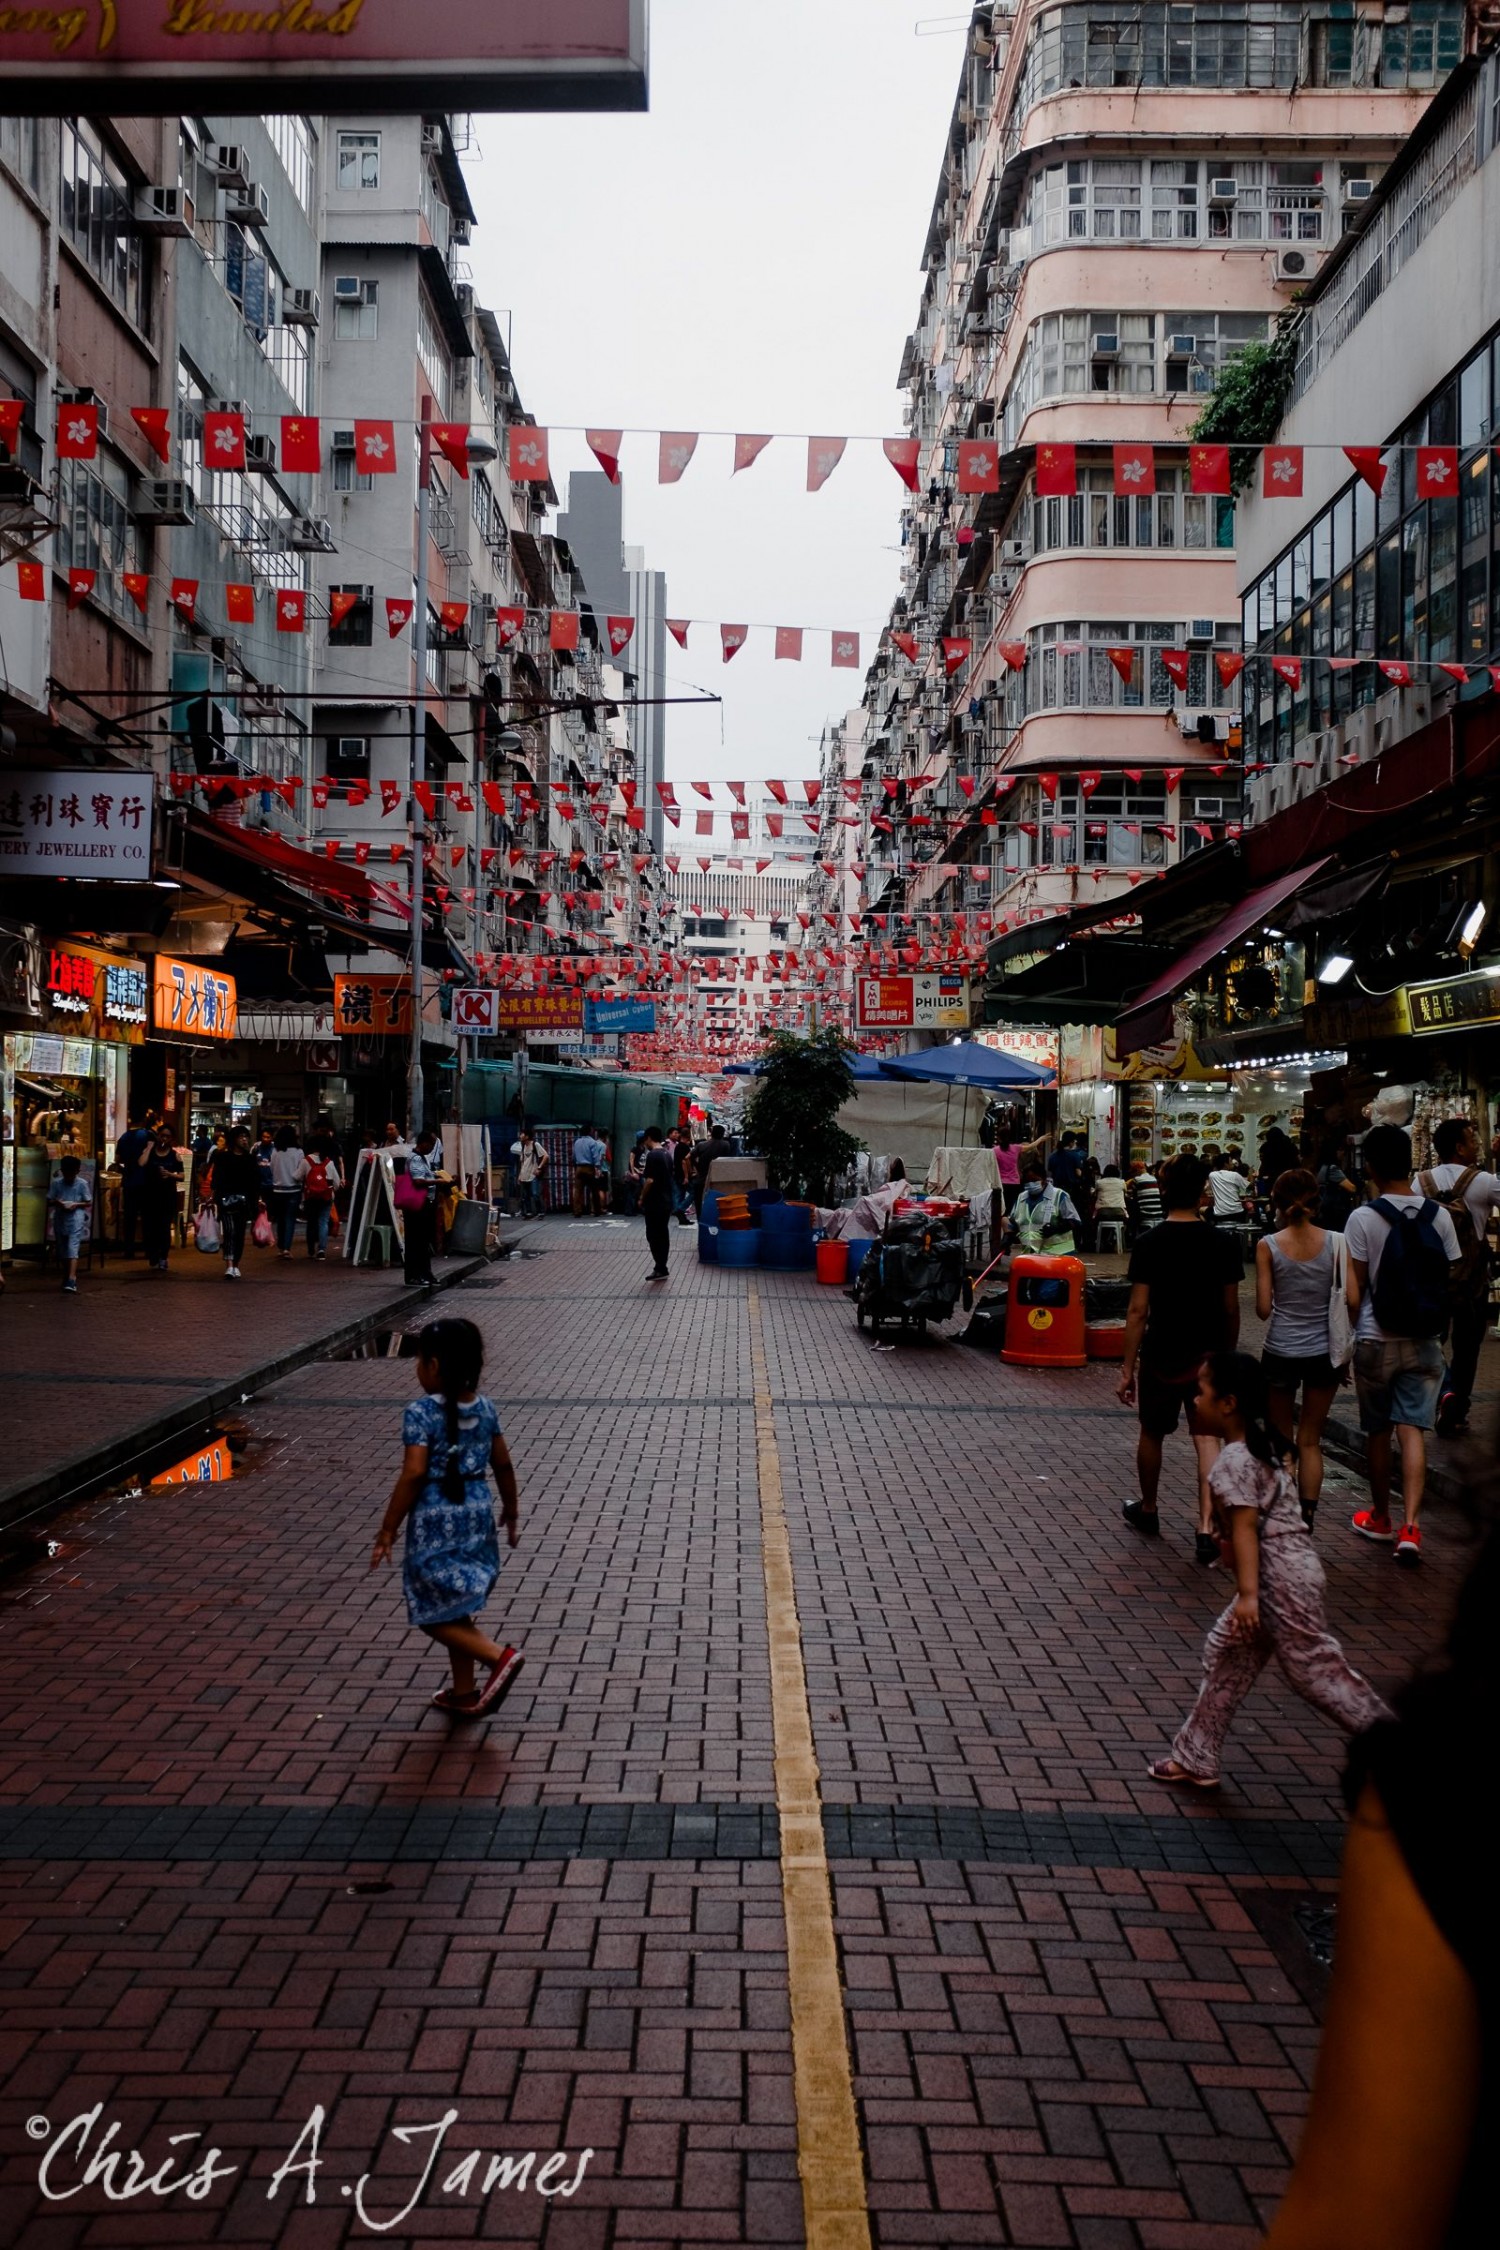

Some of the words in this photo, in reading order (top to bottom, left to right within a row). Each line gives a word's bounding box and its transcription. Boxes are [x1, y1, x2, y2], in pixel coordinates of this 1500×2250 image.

[36, 842, 117, 859] JEWELLERY
[123, 845, 146, 860] CO.
[941, 978, 963, 986] DECCA
[915, 997, 963, 1008] PHILIPS
[516, 1015, 551, 1025] JEWELLERY
[567, 1015, 582, 1025] LTD.
[595, 1007, 630, 1024] Universal
